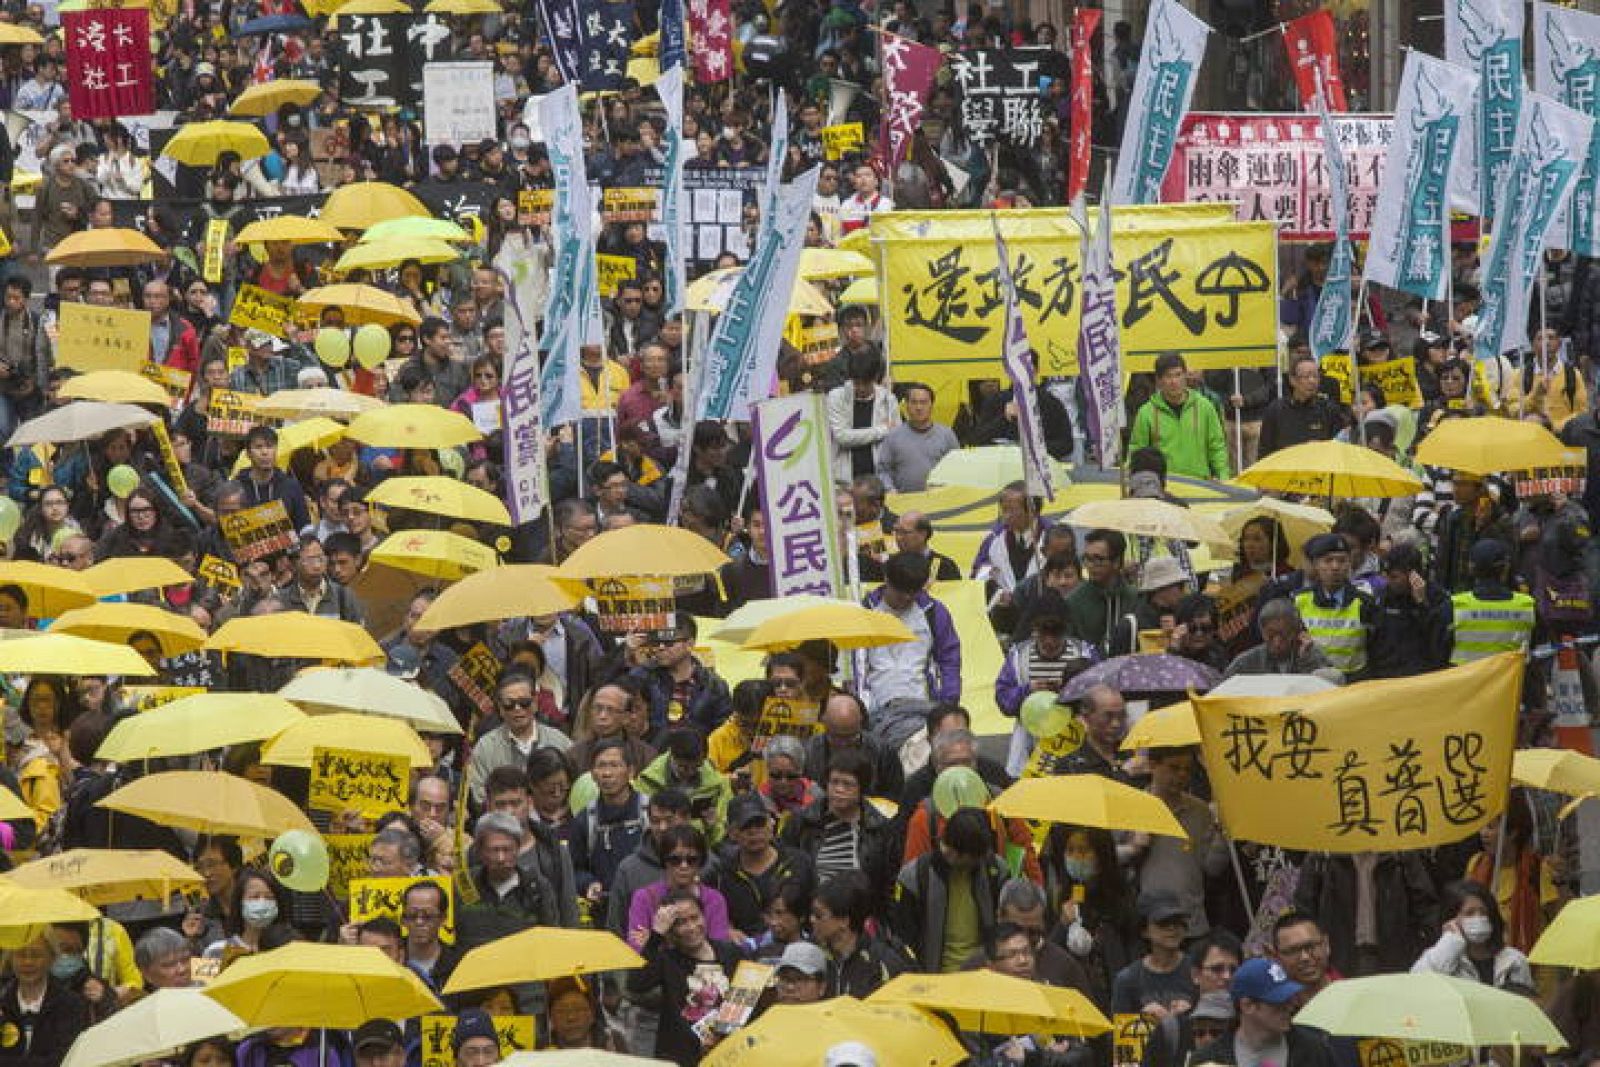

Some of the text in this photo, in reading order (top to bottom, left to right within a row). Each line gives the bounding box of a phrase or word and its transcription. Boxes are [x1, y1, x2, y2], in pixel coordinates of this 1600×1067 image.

[82, 62, 138, 89] 社工
[951, 51, 1041, 96] 社工
[962, 98, 1043, 148] 學聯
[1188, 150, 1298, 188] 雨傘運動
[1221, 709, 1331, 781] 我要
[1328, 732, 1488, 837] 真普選
